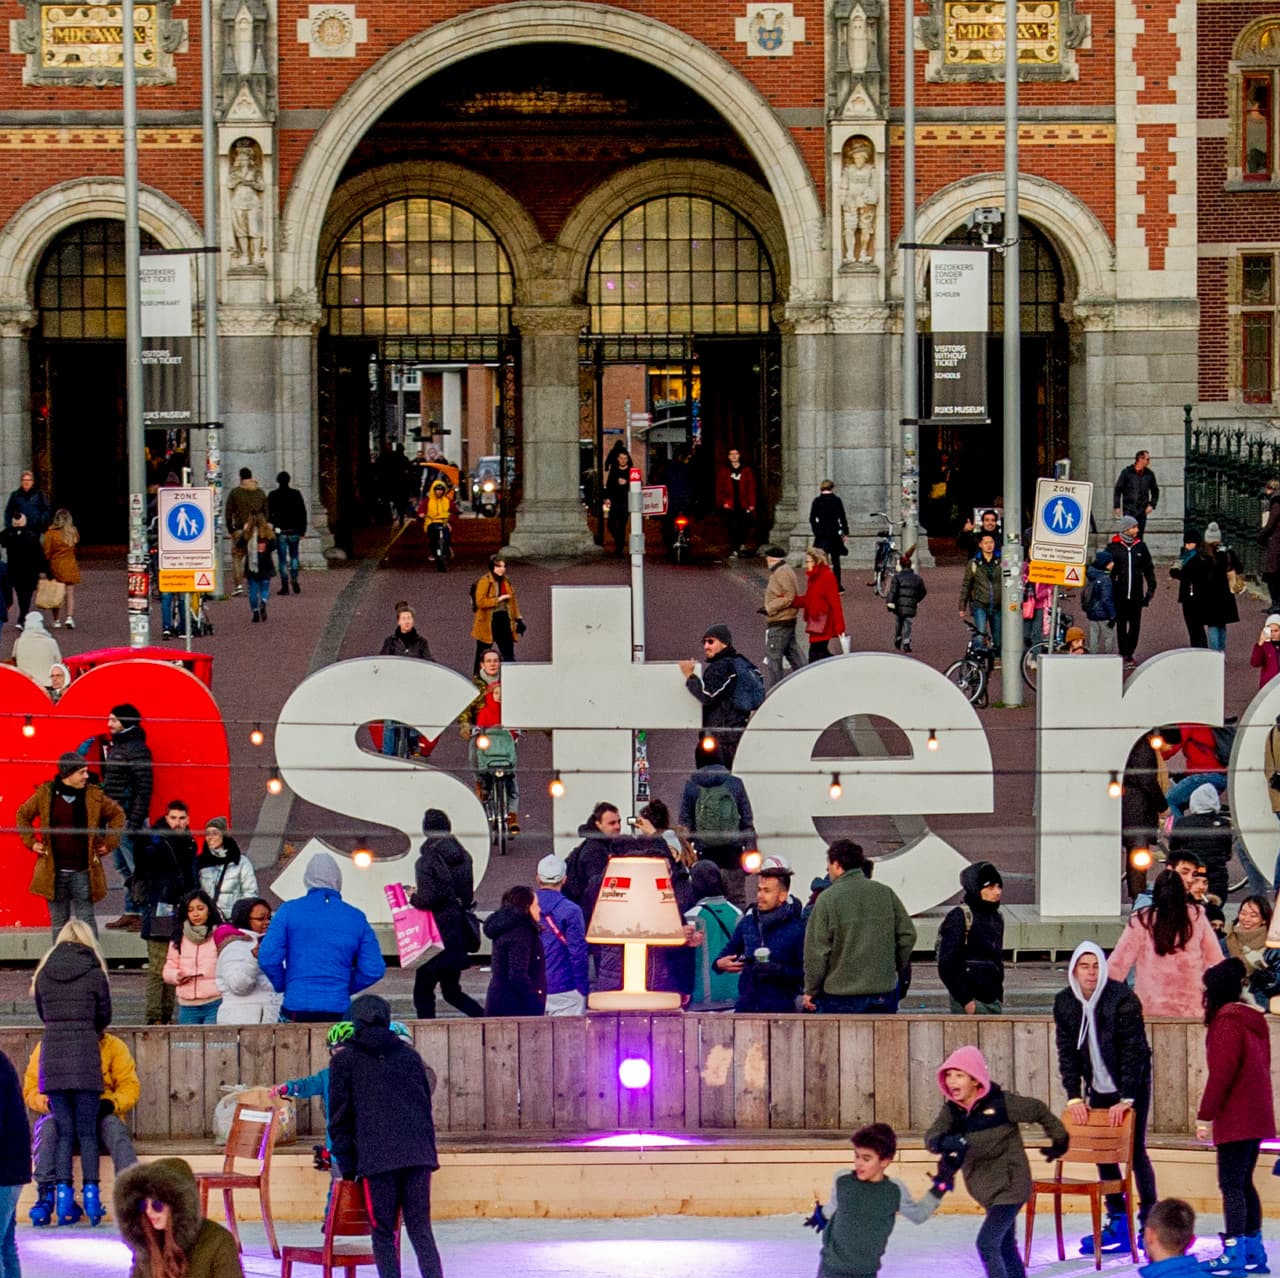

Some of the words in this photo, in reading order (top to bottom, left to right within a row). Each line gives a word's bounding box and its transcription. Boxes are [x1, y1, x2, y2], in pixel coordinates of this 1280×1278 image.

[934, 263, 975, 271] BEZOEKERS
[934, 270, 963, 278] ZONDER
[934, 344, 967, 352] VISITORS
[934, 352, 968, 360] WITHOUT
[934, 359, 958, 367] TICKET
[954, 406, 985, 414] MUSEUM
[1053, 485, 1078, 494] ZONE
[174, 492, 198, 500] ZONE
